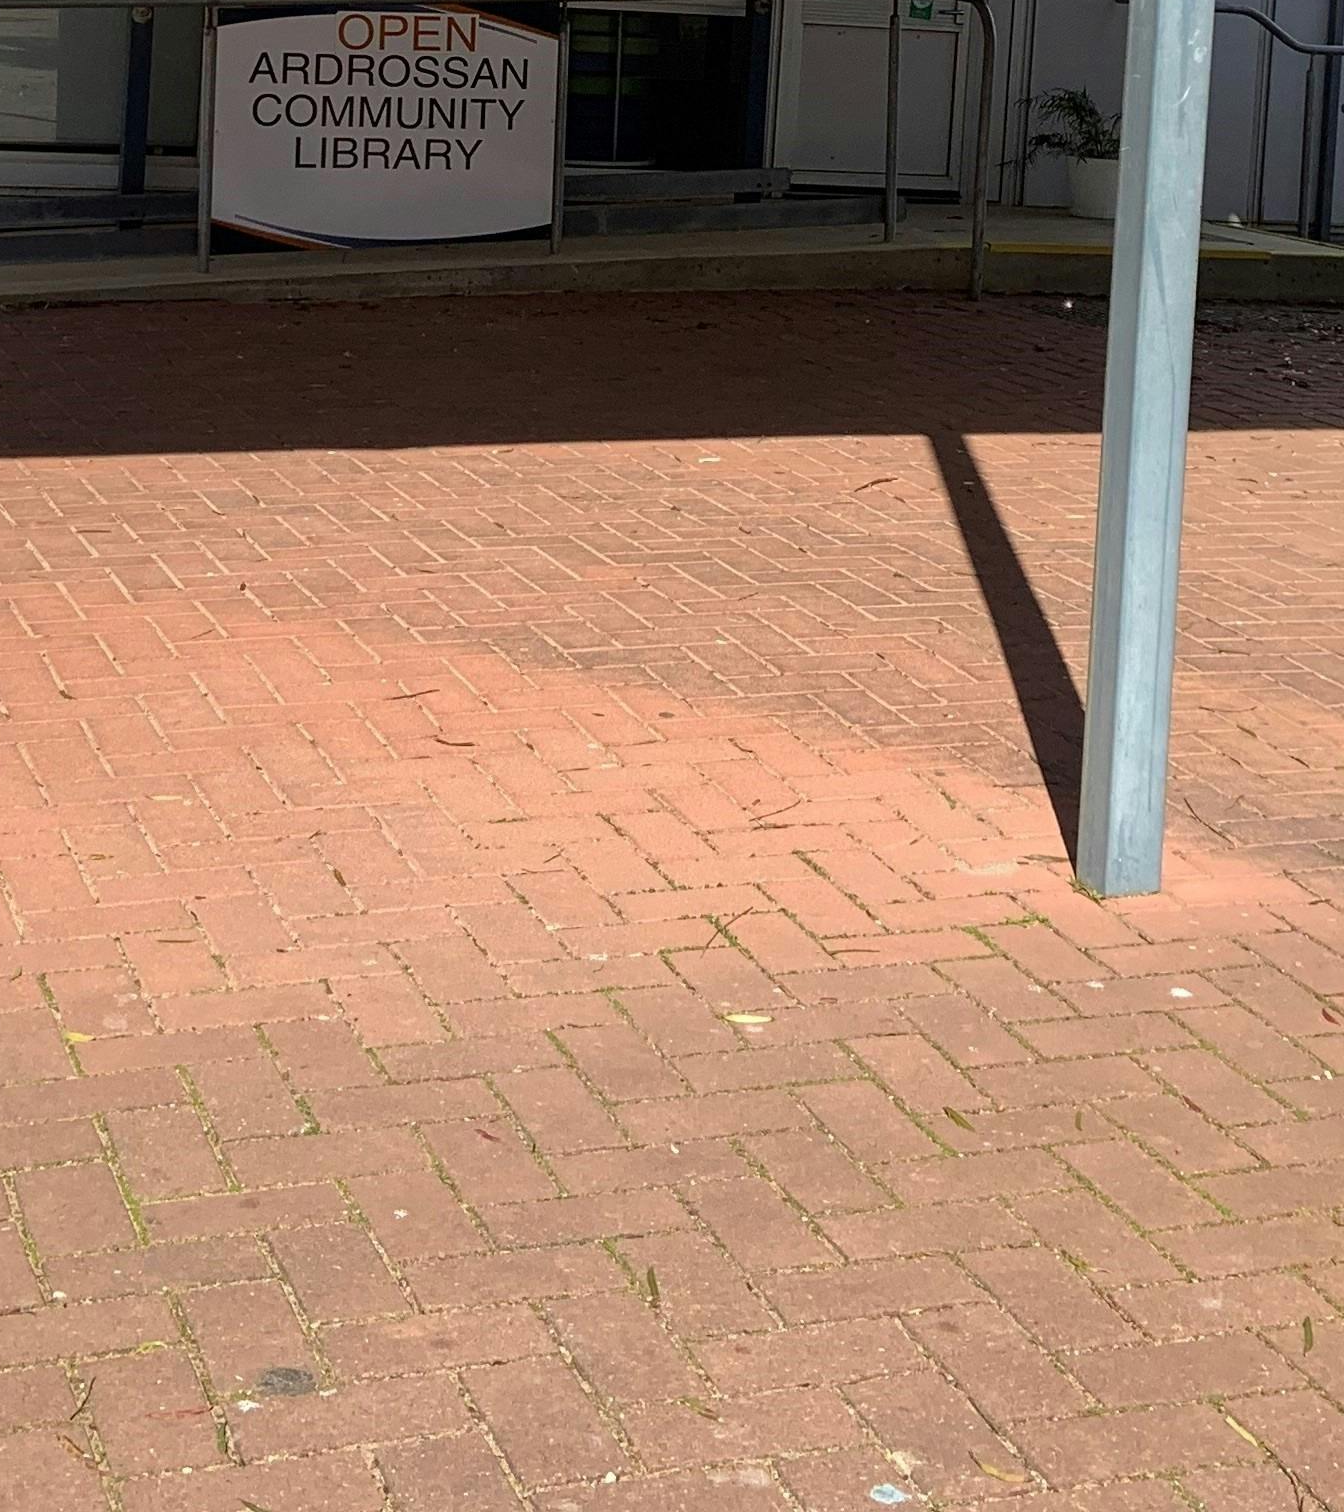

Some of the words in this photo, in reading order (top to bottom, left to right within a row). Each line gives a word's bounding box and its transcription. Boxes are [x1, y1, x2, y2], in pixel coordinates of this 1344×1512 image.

[337, 14, 477, 52] OPEN
[248, 52, 528, 90] ARDROSSAN
[251, 93, 525, 130] COMMUNITY
[294, 137, 483, 170] LIBRARY
